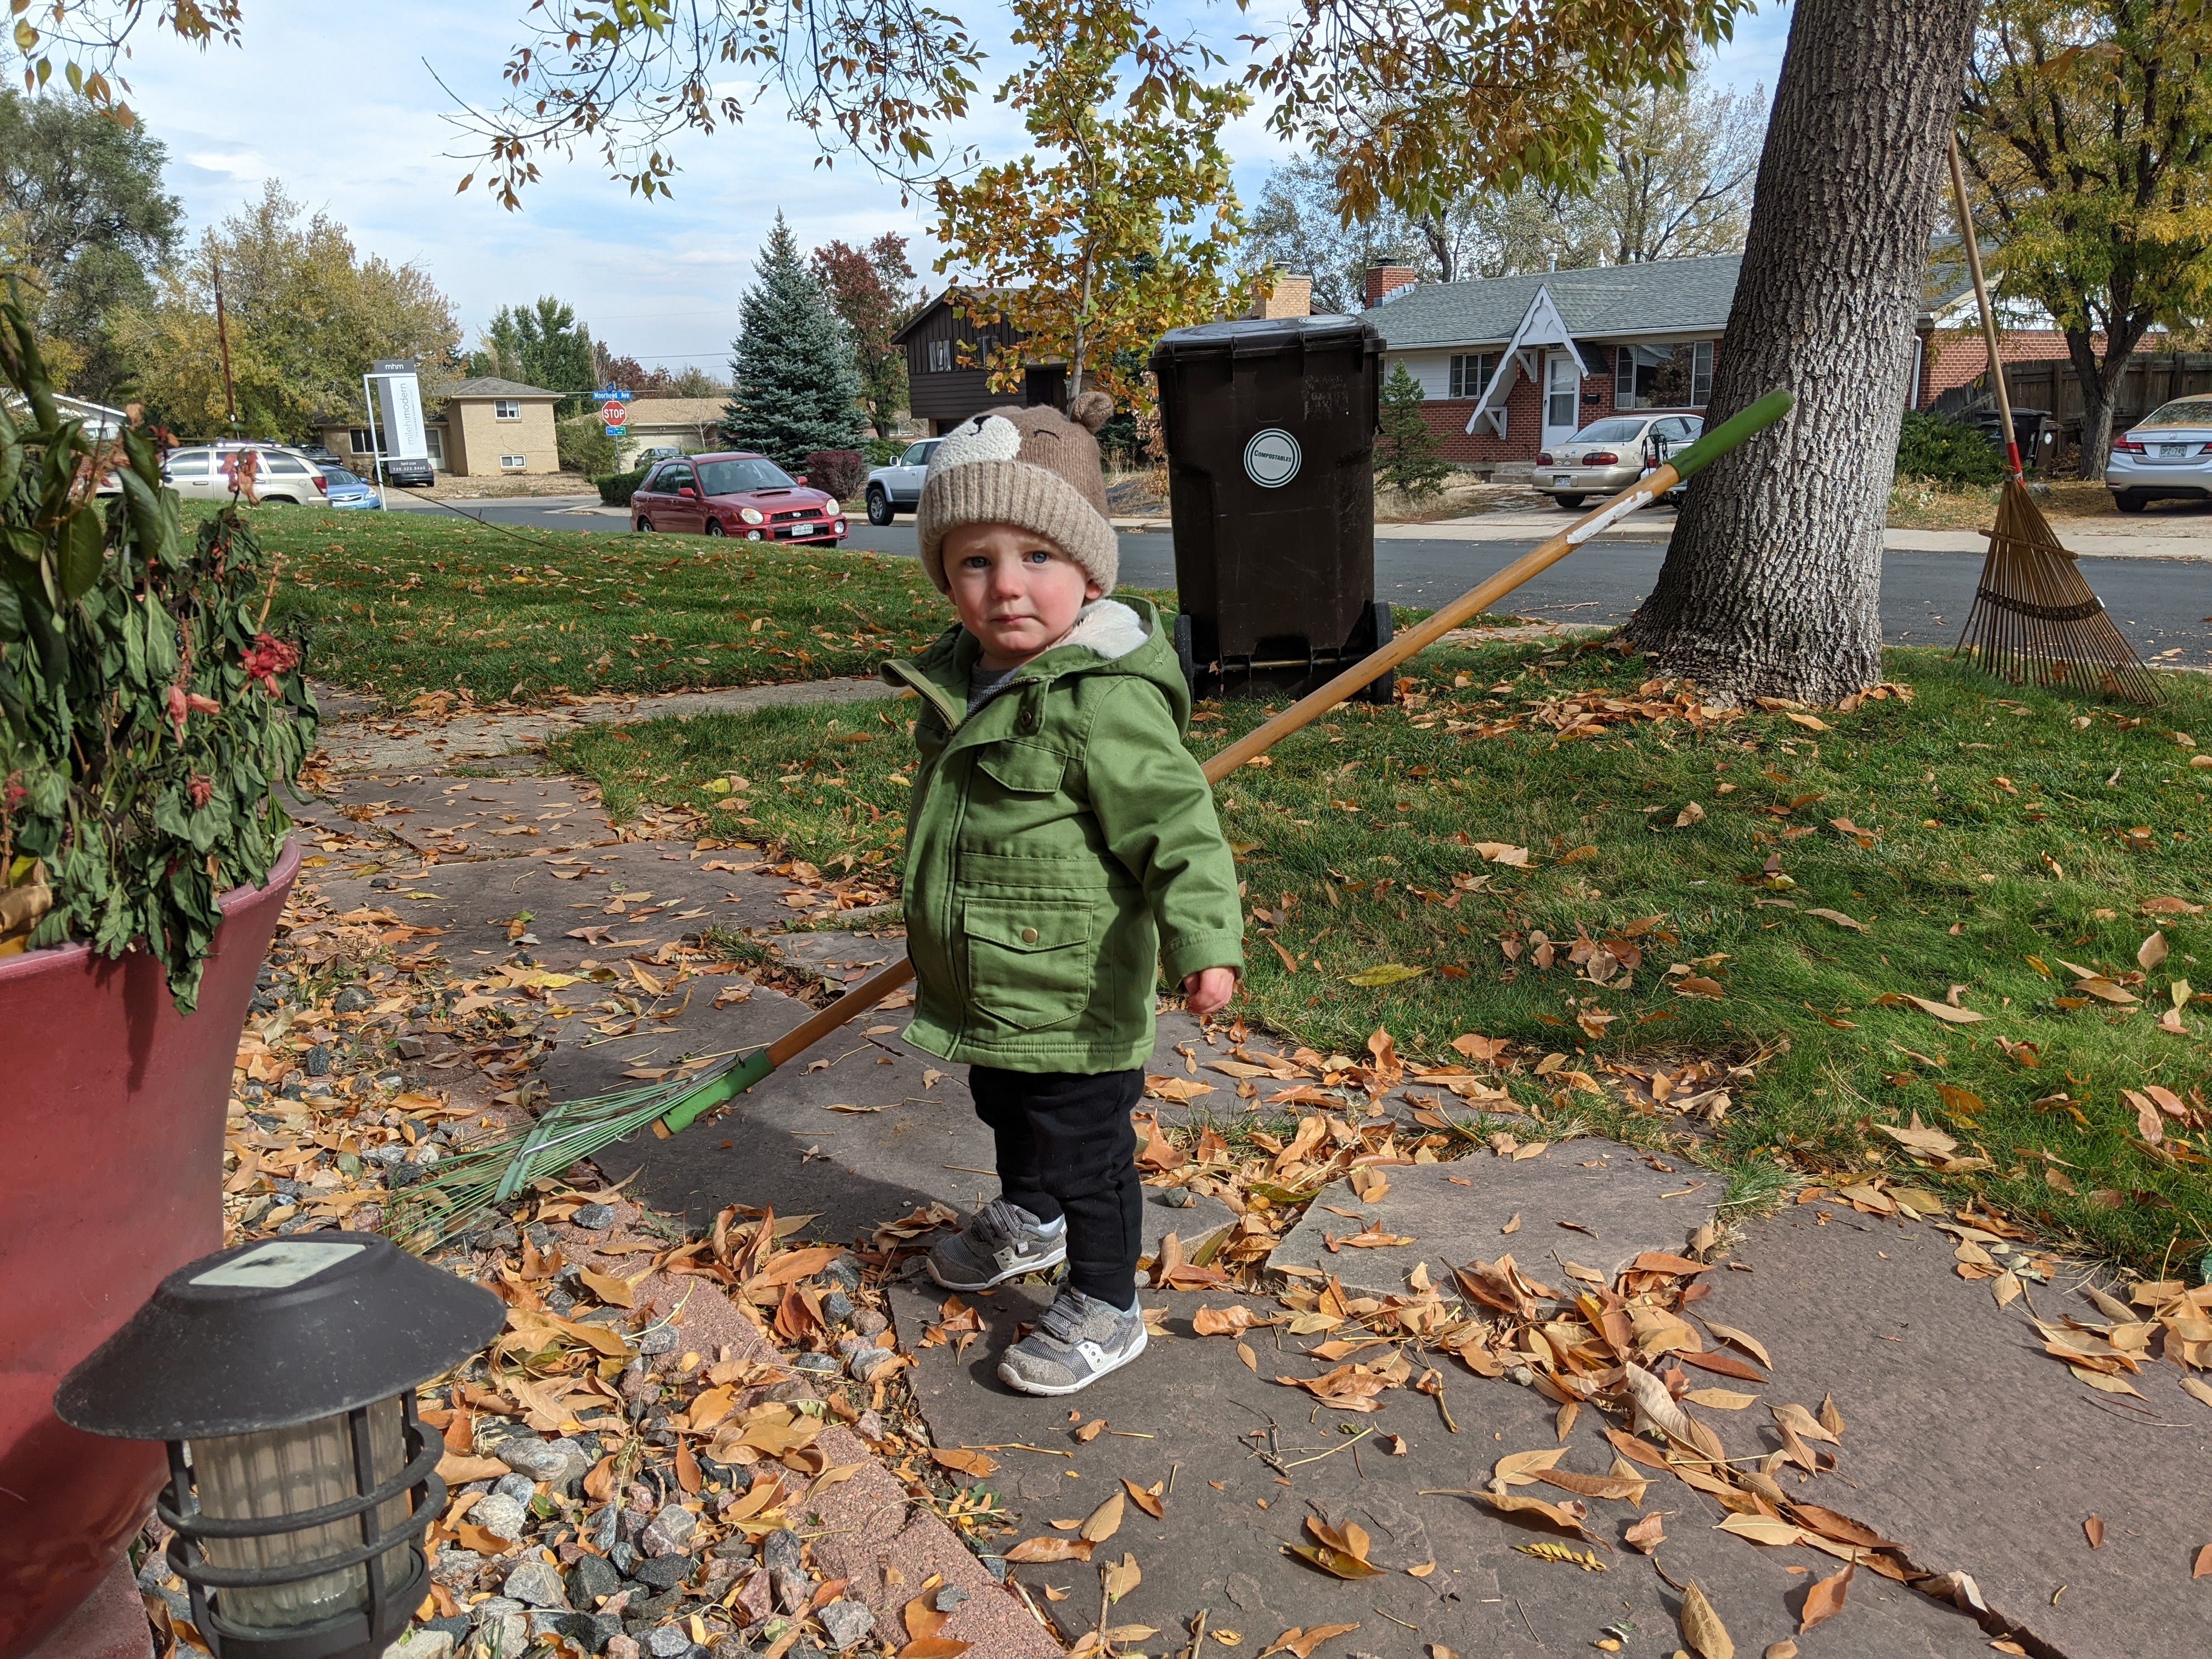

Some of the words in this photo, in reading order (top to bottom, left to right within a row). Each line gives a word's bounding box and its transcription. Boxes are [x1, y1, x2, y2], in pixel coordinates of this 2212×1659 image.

[400, 383, 414, 445] milehimodern
[604, 409, 624, 419] STOP
[1254, 450, 1292, 462] COMPOSTABLES
